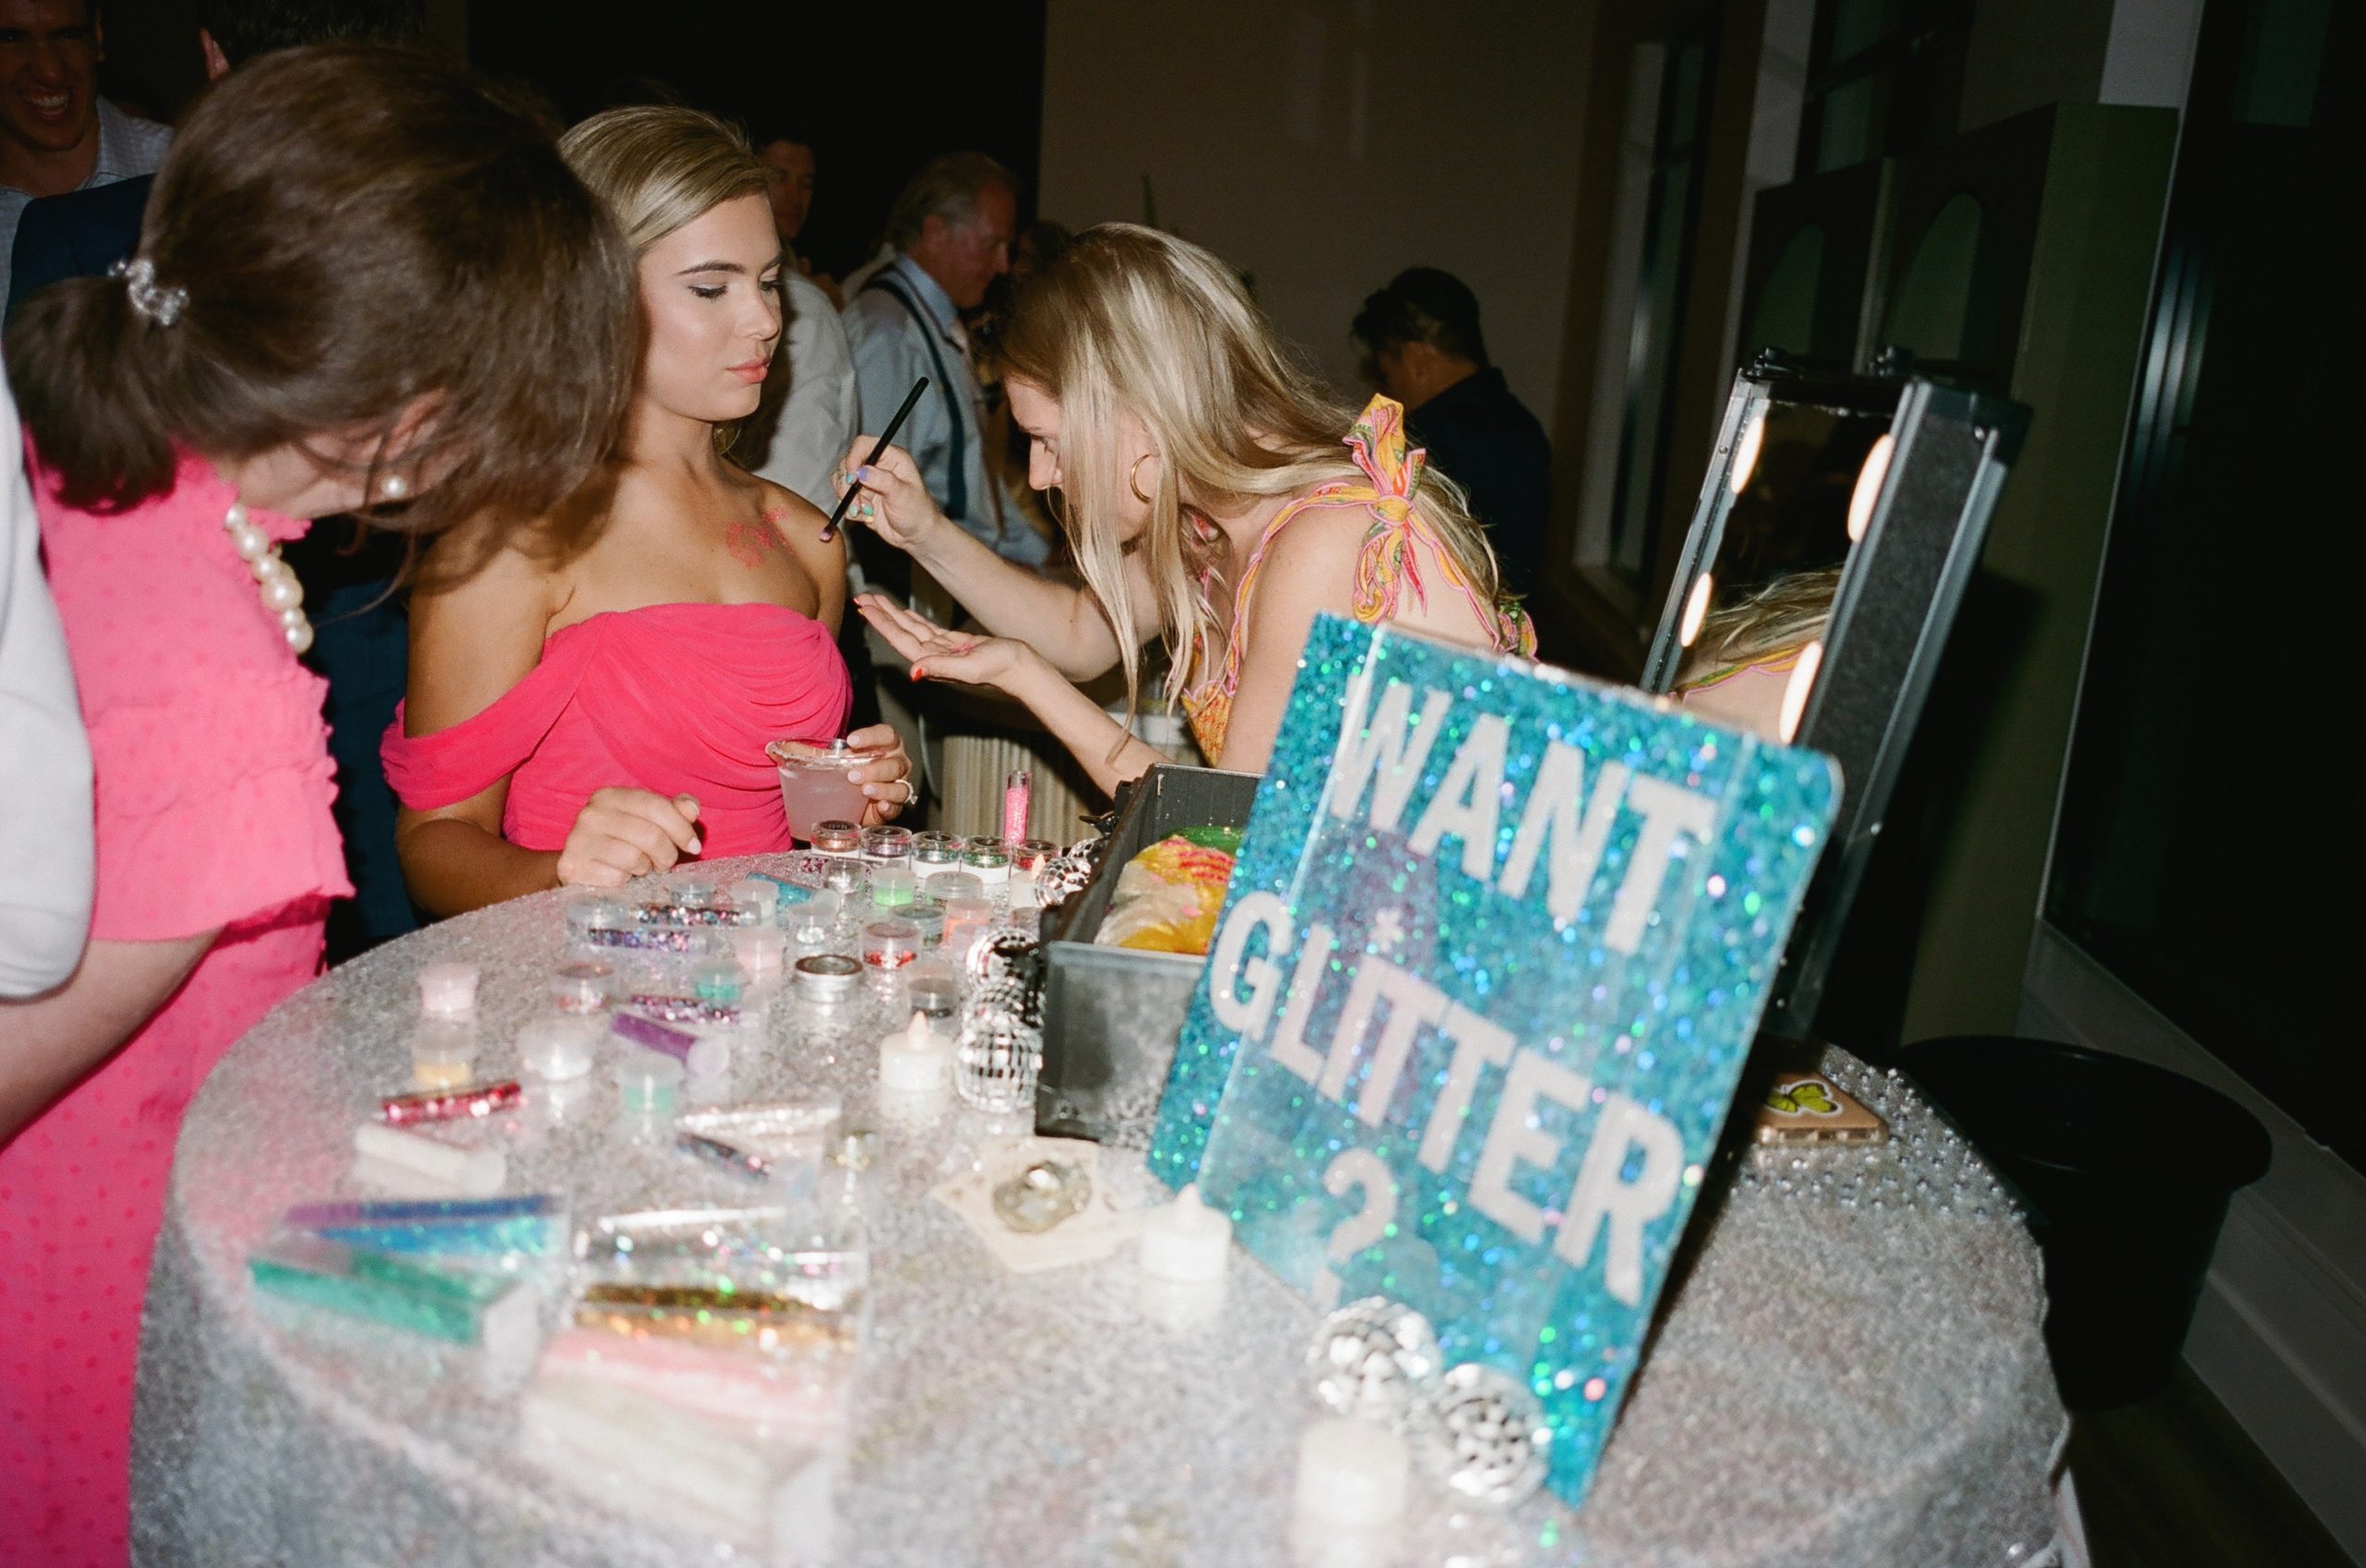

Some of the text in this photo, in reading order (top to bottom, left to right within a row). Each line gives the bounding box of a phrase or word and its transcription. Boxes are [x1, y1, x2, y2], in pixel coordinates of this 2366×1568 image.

[1330, 675, 1718, 955] WANT
[1210, 893, 1682, 1305] GLITTER
[1322, 1149, 1396, 1305] ?
